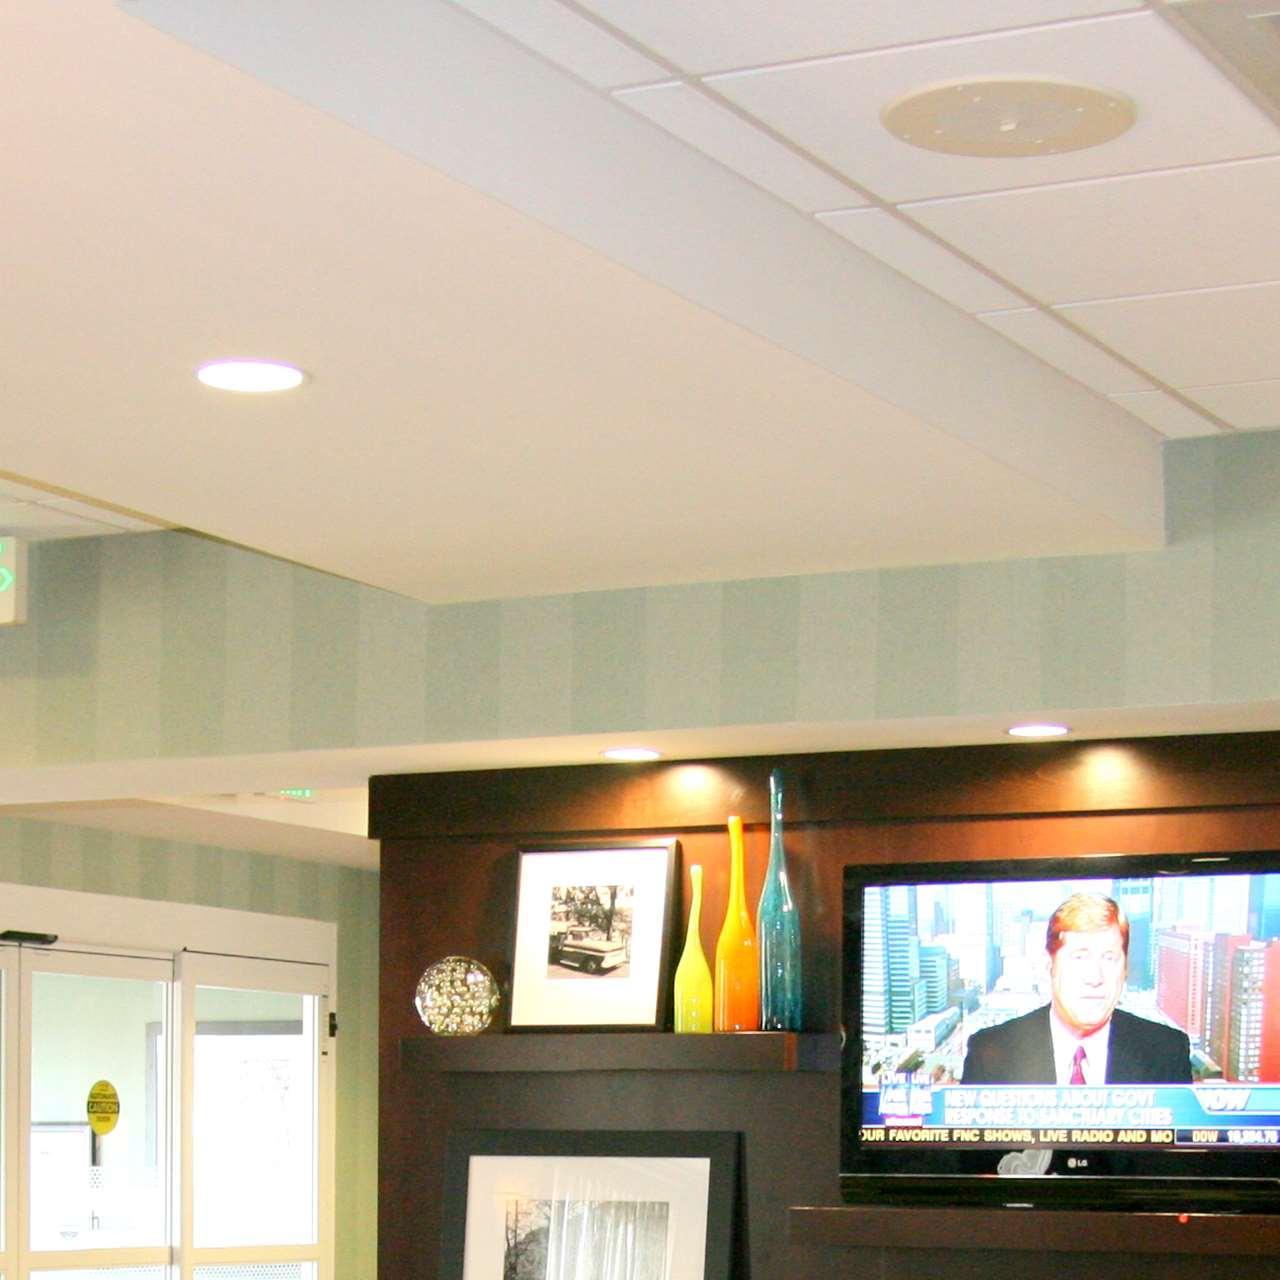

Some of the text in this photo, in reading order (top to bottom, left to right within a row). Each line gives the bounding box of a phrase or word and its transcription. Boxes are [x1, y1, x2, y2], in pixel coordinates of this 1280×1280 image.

[88, 1102, 118, 1113] CAUTION
[889, 1129, 949, 1142] FAVORITE
[953, 1129, 980, 1142] FNC
[984, 1129, 1036, 1144] SHOWS,
[1039, 1129, 1068, 1142] LIVE
[1072, 1129, 1114, 1142] RADIO
[1117, 1129, 1147, 1142] AND
[1192, 1130, 1218, 1142] DOW
